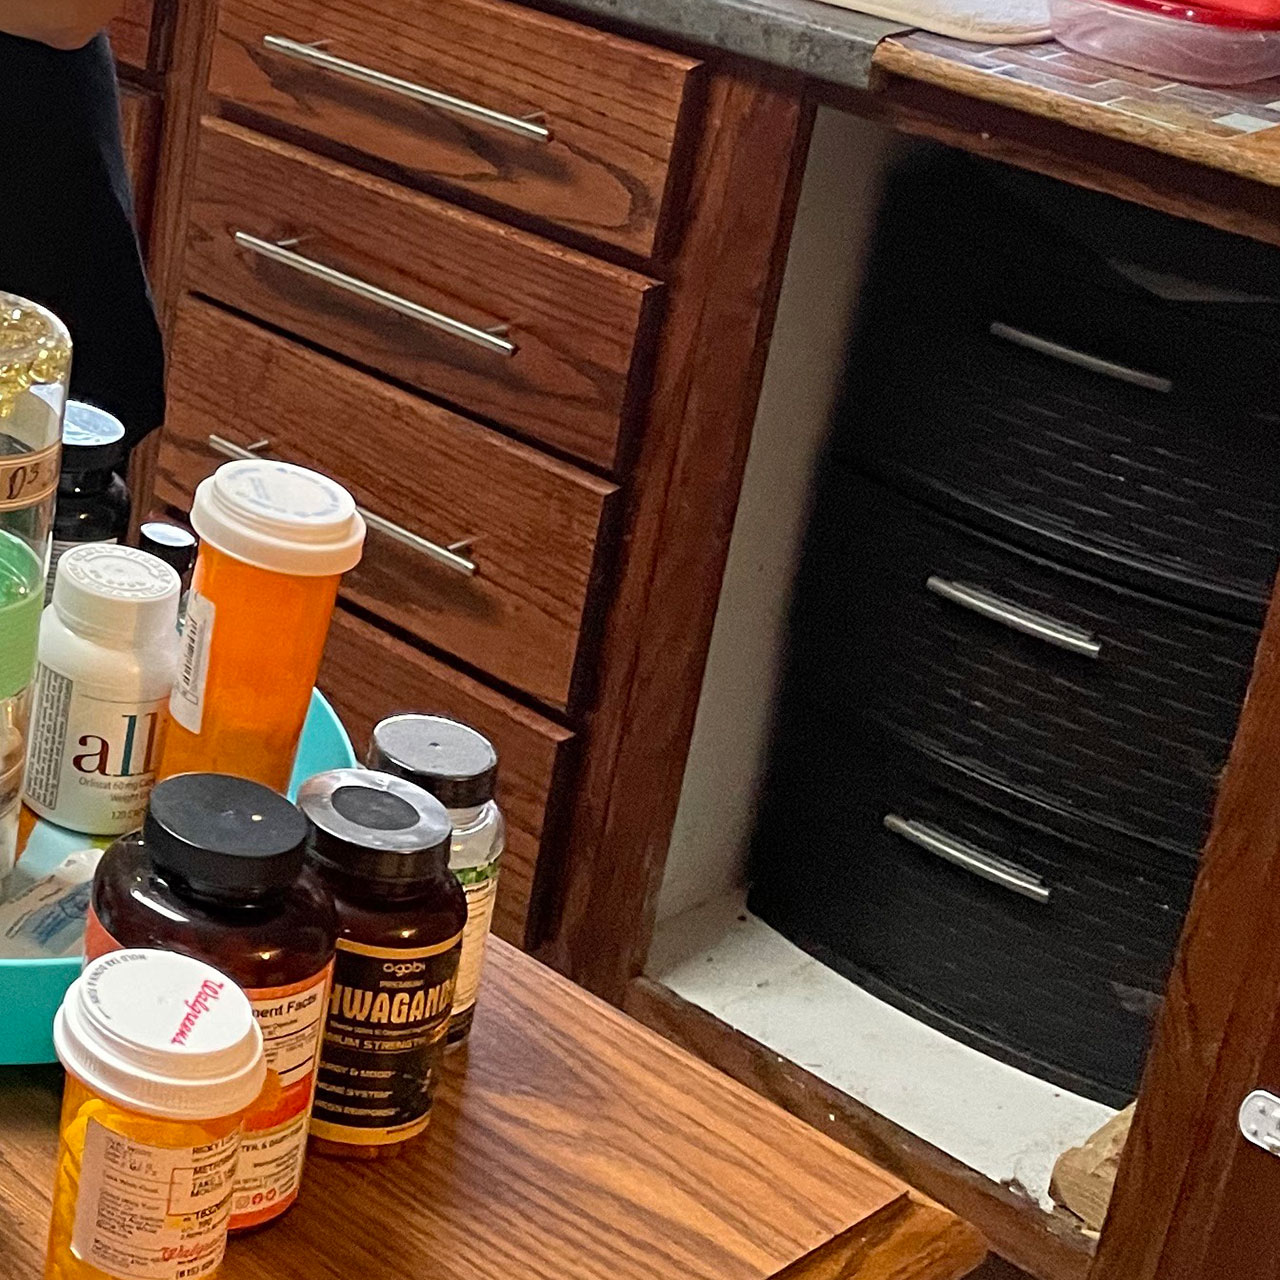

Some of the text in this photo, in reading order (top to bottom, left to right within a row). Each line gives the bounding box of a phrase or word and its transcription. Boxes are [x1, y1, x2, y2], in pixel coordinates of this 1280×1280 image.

[72, 712, 160, 777] all
[170, 978, 225, 1047] Walgreens
[286, 992, 318, 1012] Facts
